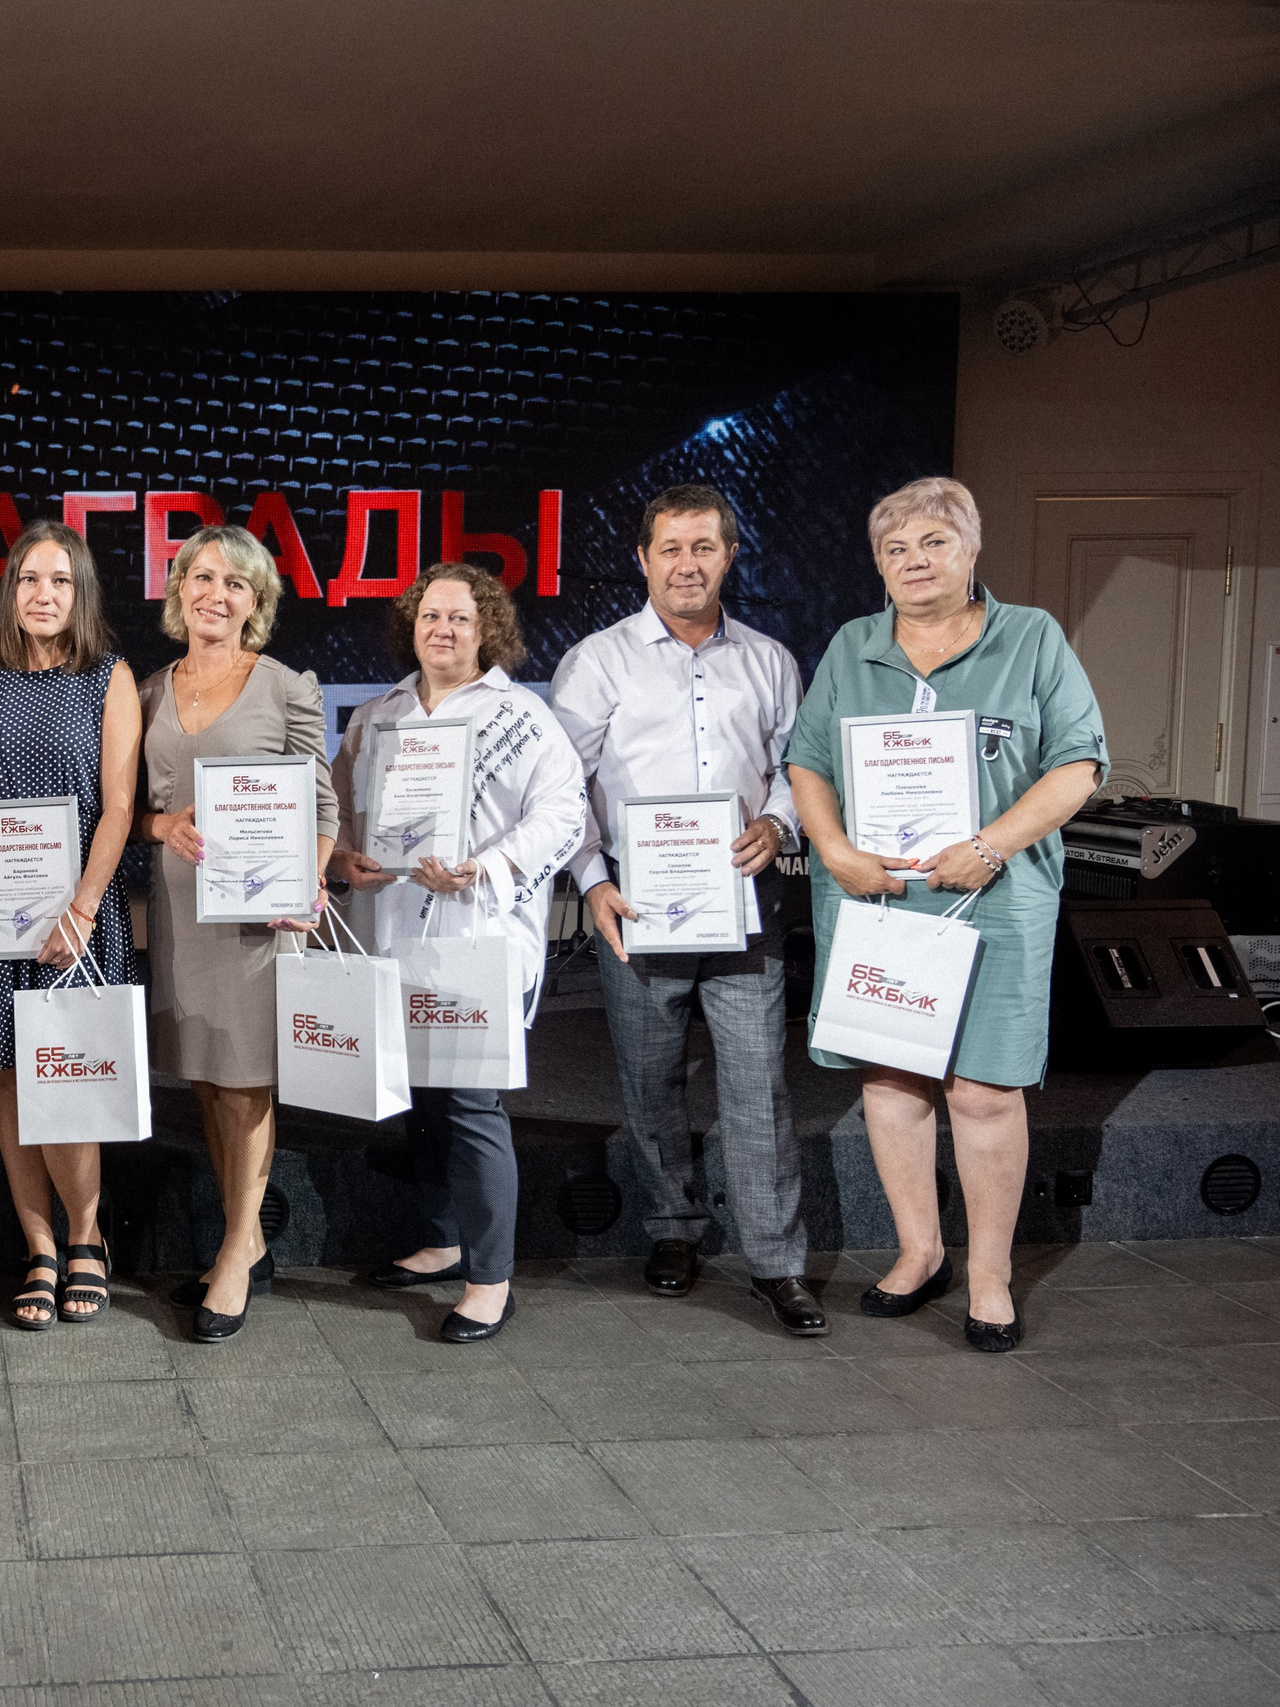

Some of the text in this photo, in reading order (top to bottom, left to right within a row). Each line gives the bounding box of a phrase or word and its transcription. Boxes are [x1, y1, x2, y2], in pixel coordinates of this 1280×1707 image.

[403, 738, 416, 746] 65
[884, 738, 932, 747] КЖБМК
[402, 745, 439, 753] КЖБМК
[865, 757, 927, 767] БЛАГОДАРСТВЕННОЕ
[2, 825, 42, 833] КЖБМК
[655, 820, 699, 829] КЖБМК
[638, 839, 694, 848] БЛАГОДАРСТВЕННОЕ
[1088, 852, 1128, 865] X-STREAM
[852, 964, 885, 983] 65
[410, 994, 438, 1008] 65
[847, 979, 938, 1011] КЖБМК
[293, 1013, 317, 1030] 65
[410, 1010, 488, 1023] КЖБМК
[294, 1030, 359, 1052] КЖБМК
[36, 1047, 65, 1062] 65
[37, 1061, 116, 1078] КЖБМК
